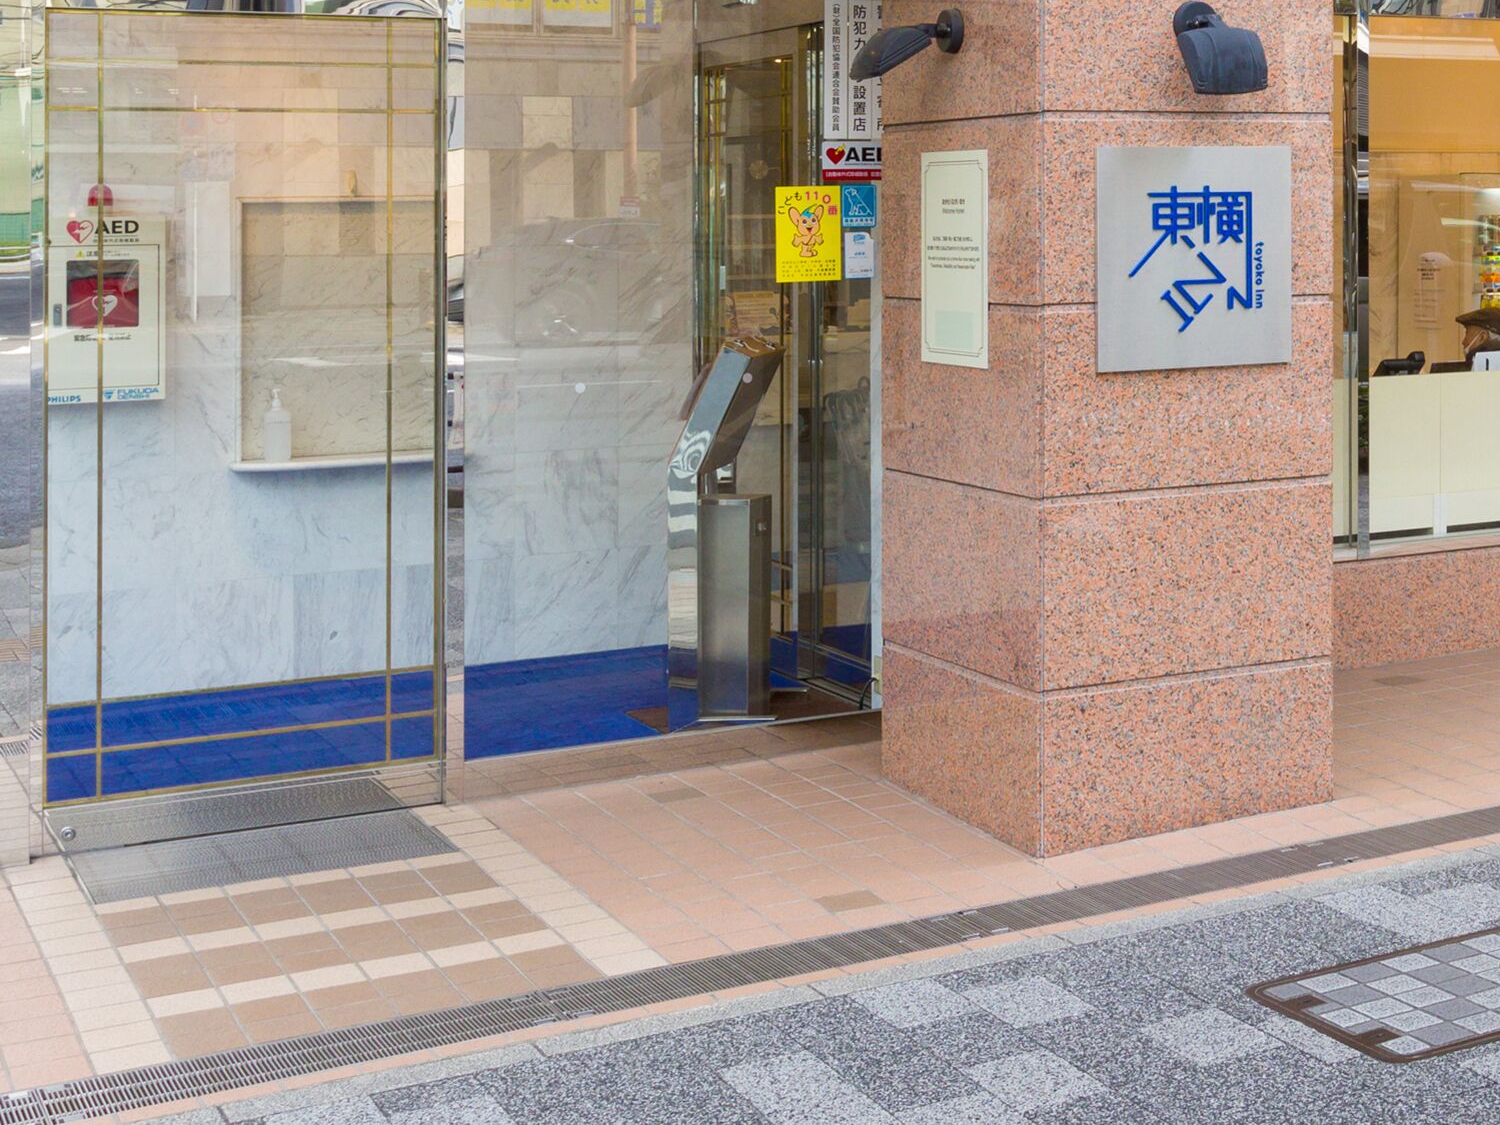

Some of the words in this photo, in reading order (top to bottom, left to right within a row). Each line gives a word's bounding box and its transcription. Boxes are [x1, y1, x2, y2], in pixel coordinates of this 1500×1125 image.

[95, 220, 140, 235] AED
[1253, 241, 1265, 286] toyoko
[117, 387, 160, 396] FUKUDA
